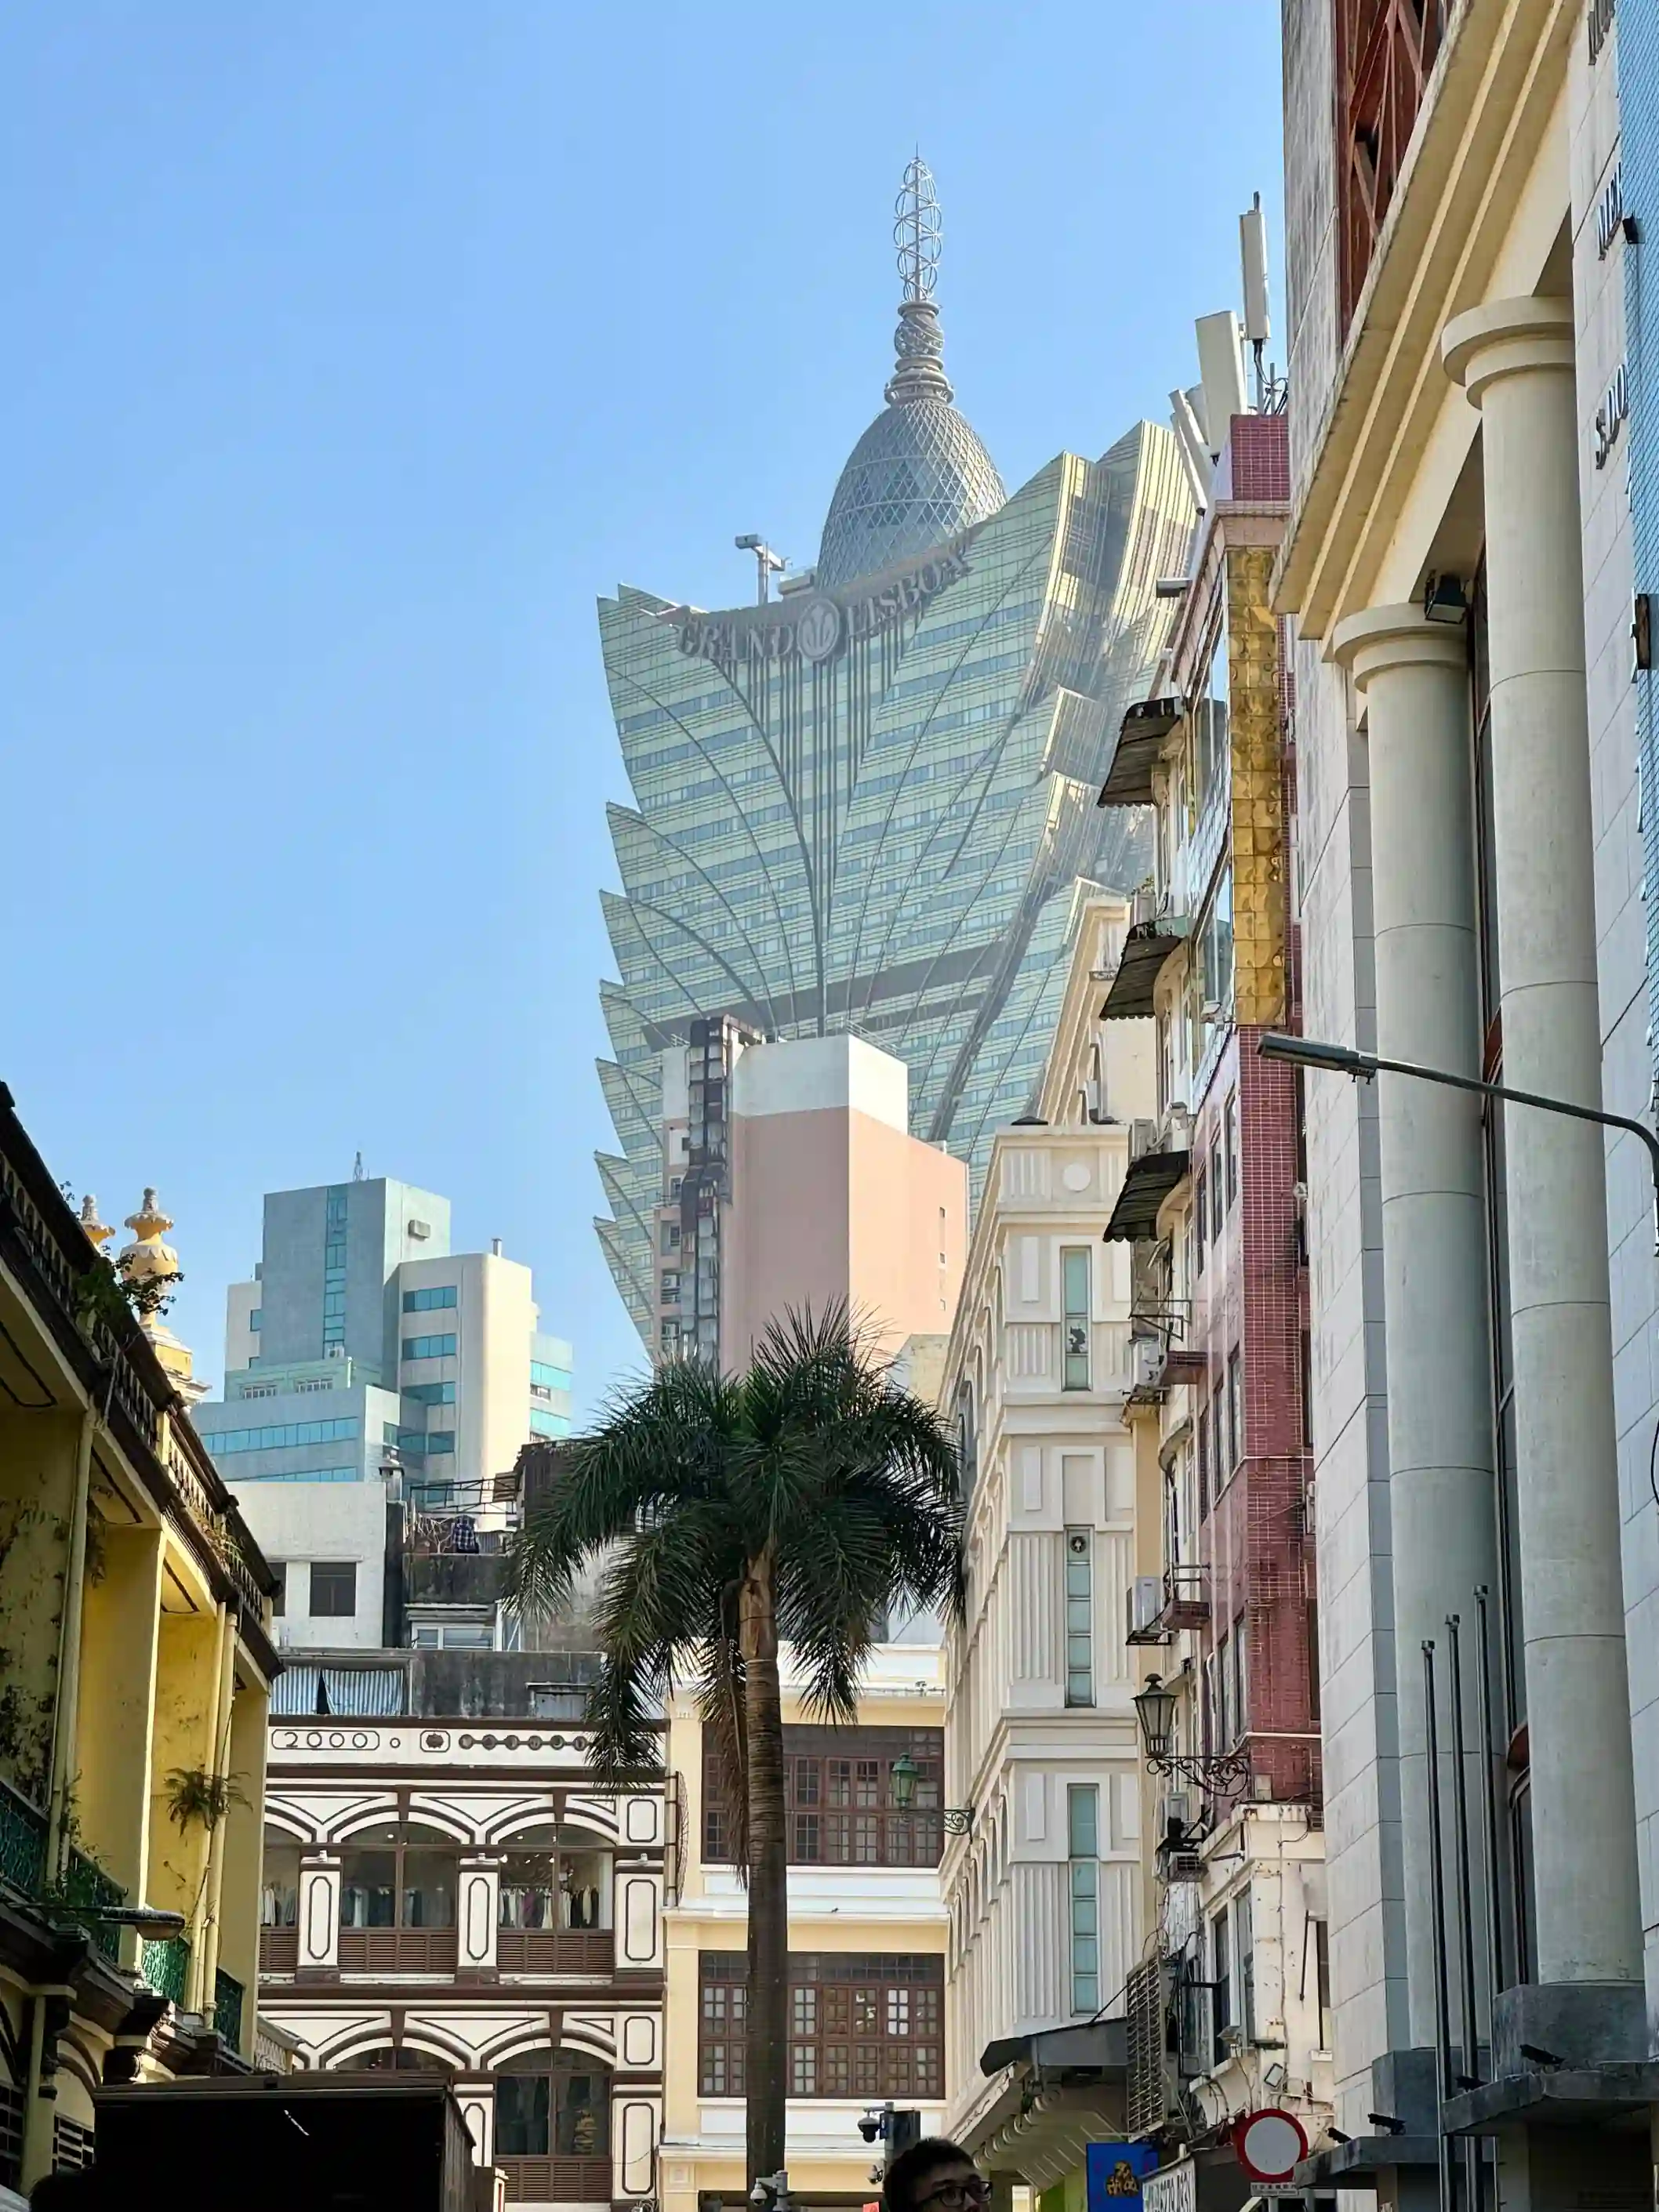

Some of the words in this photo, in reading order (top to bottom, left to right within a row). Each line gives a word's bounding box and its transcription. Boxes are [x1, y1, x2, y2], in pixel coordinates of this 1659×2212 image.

[677, 619, 793, 661] GRAND
[845, 552, 971, 637] LISBOA
[284, 1732, 368, 1749] 2000
